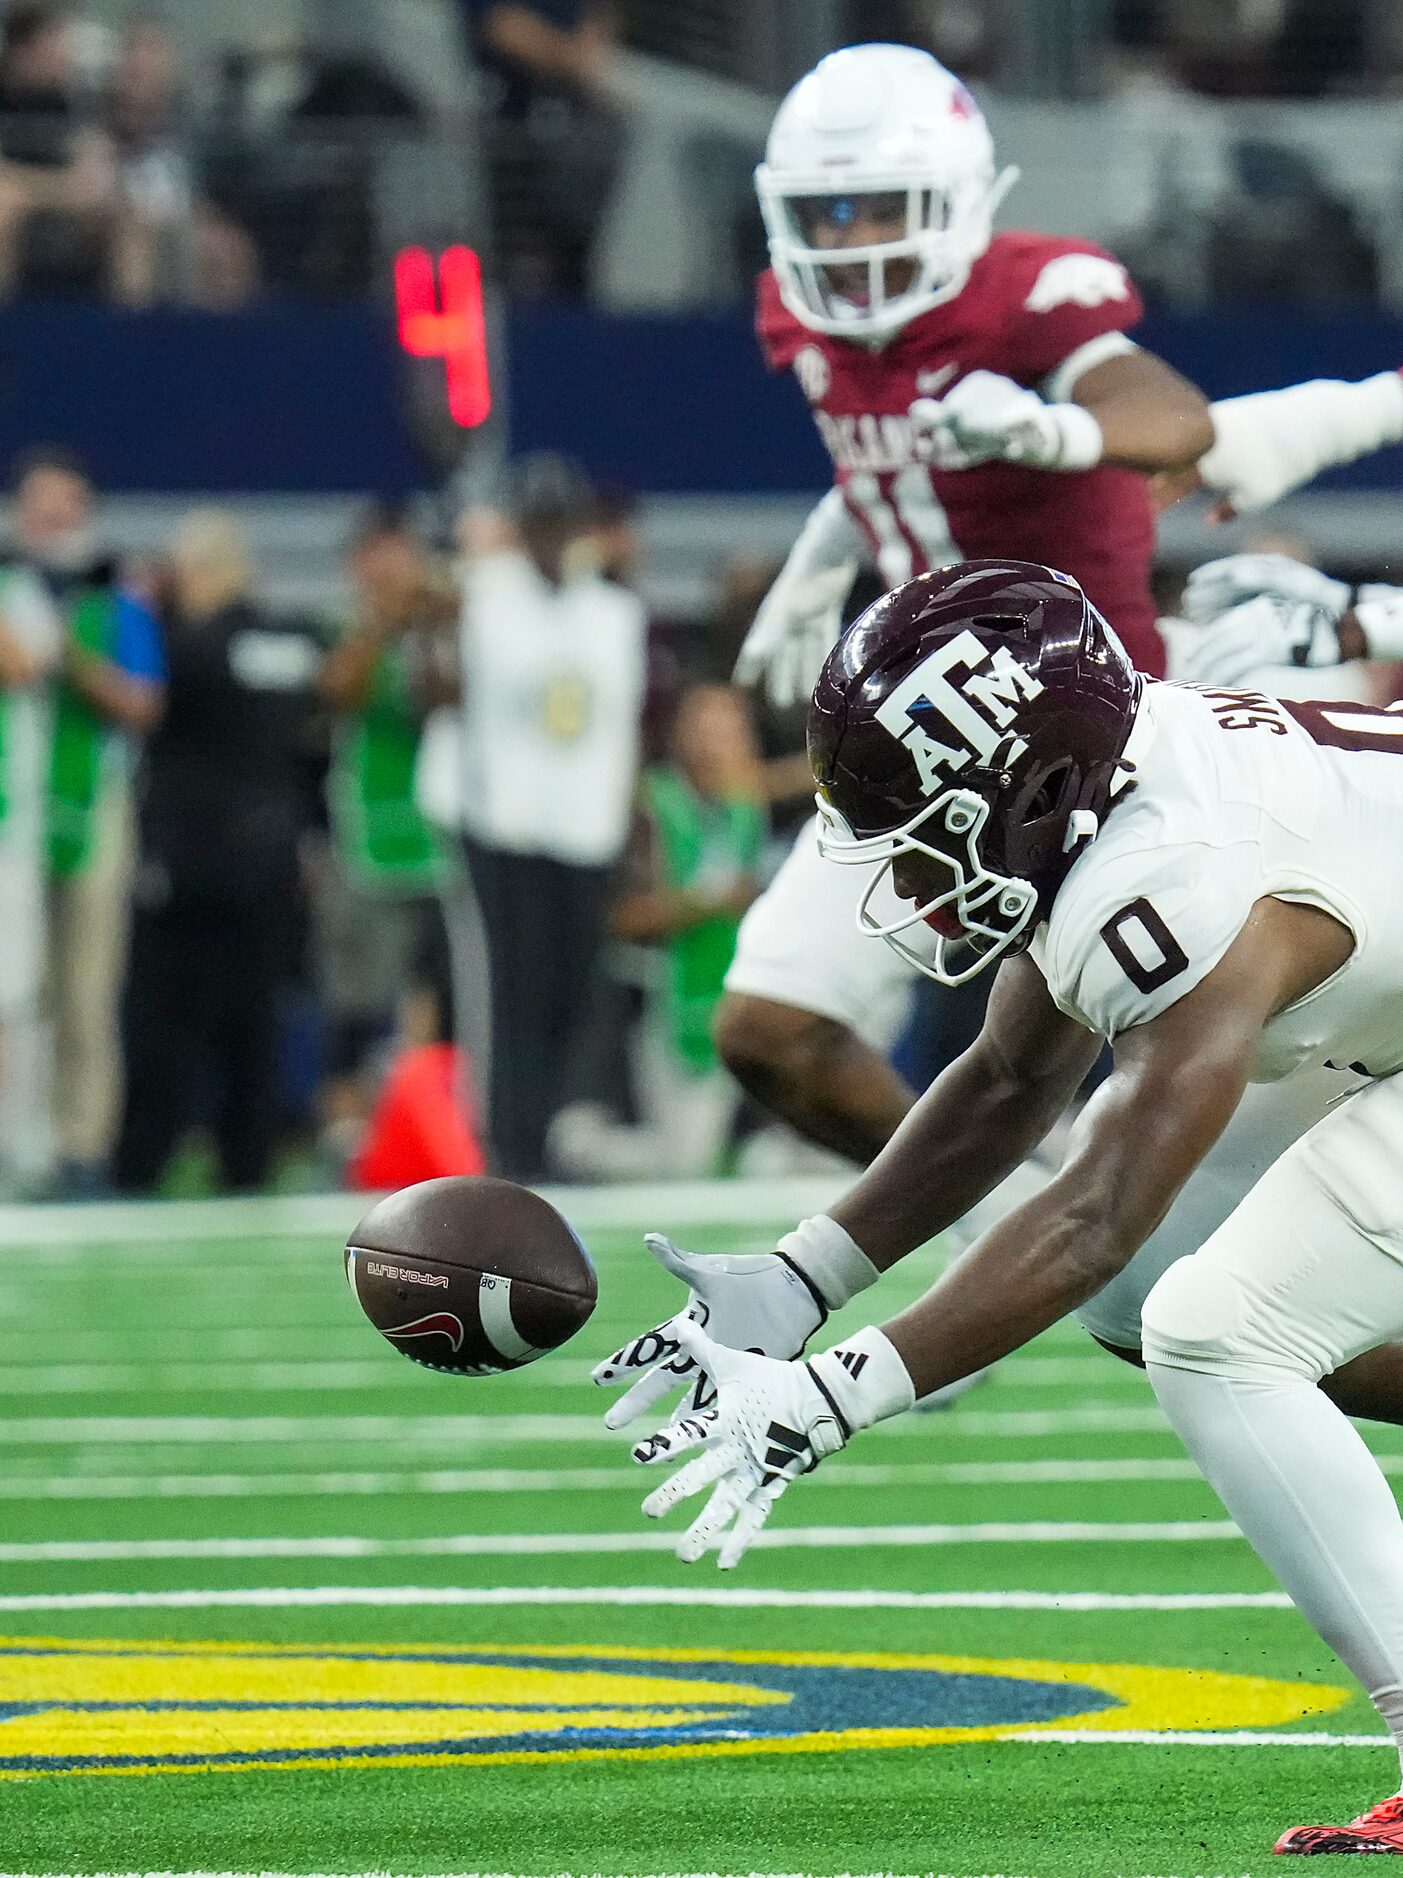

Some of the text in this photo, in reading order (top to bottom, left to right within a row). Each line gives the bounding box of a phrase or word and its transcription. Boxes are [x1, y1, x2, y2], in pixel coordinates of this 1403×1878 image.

[394, 244, 491, 428] 4
[1099, 897, 1189, 994] 0
[367, 1262, 449, 1289] VAPOR ELITE
